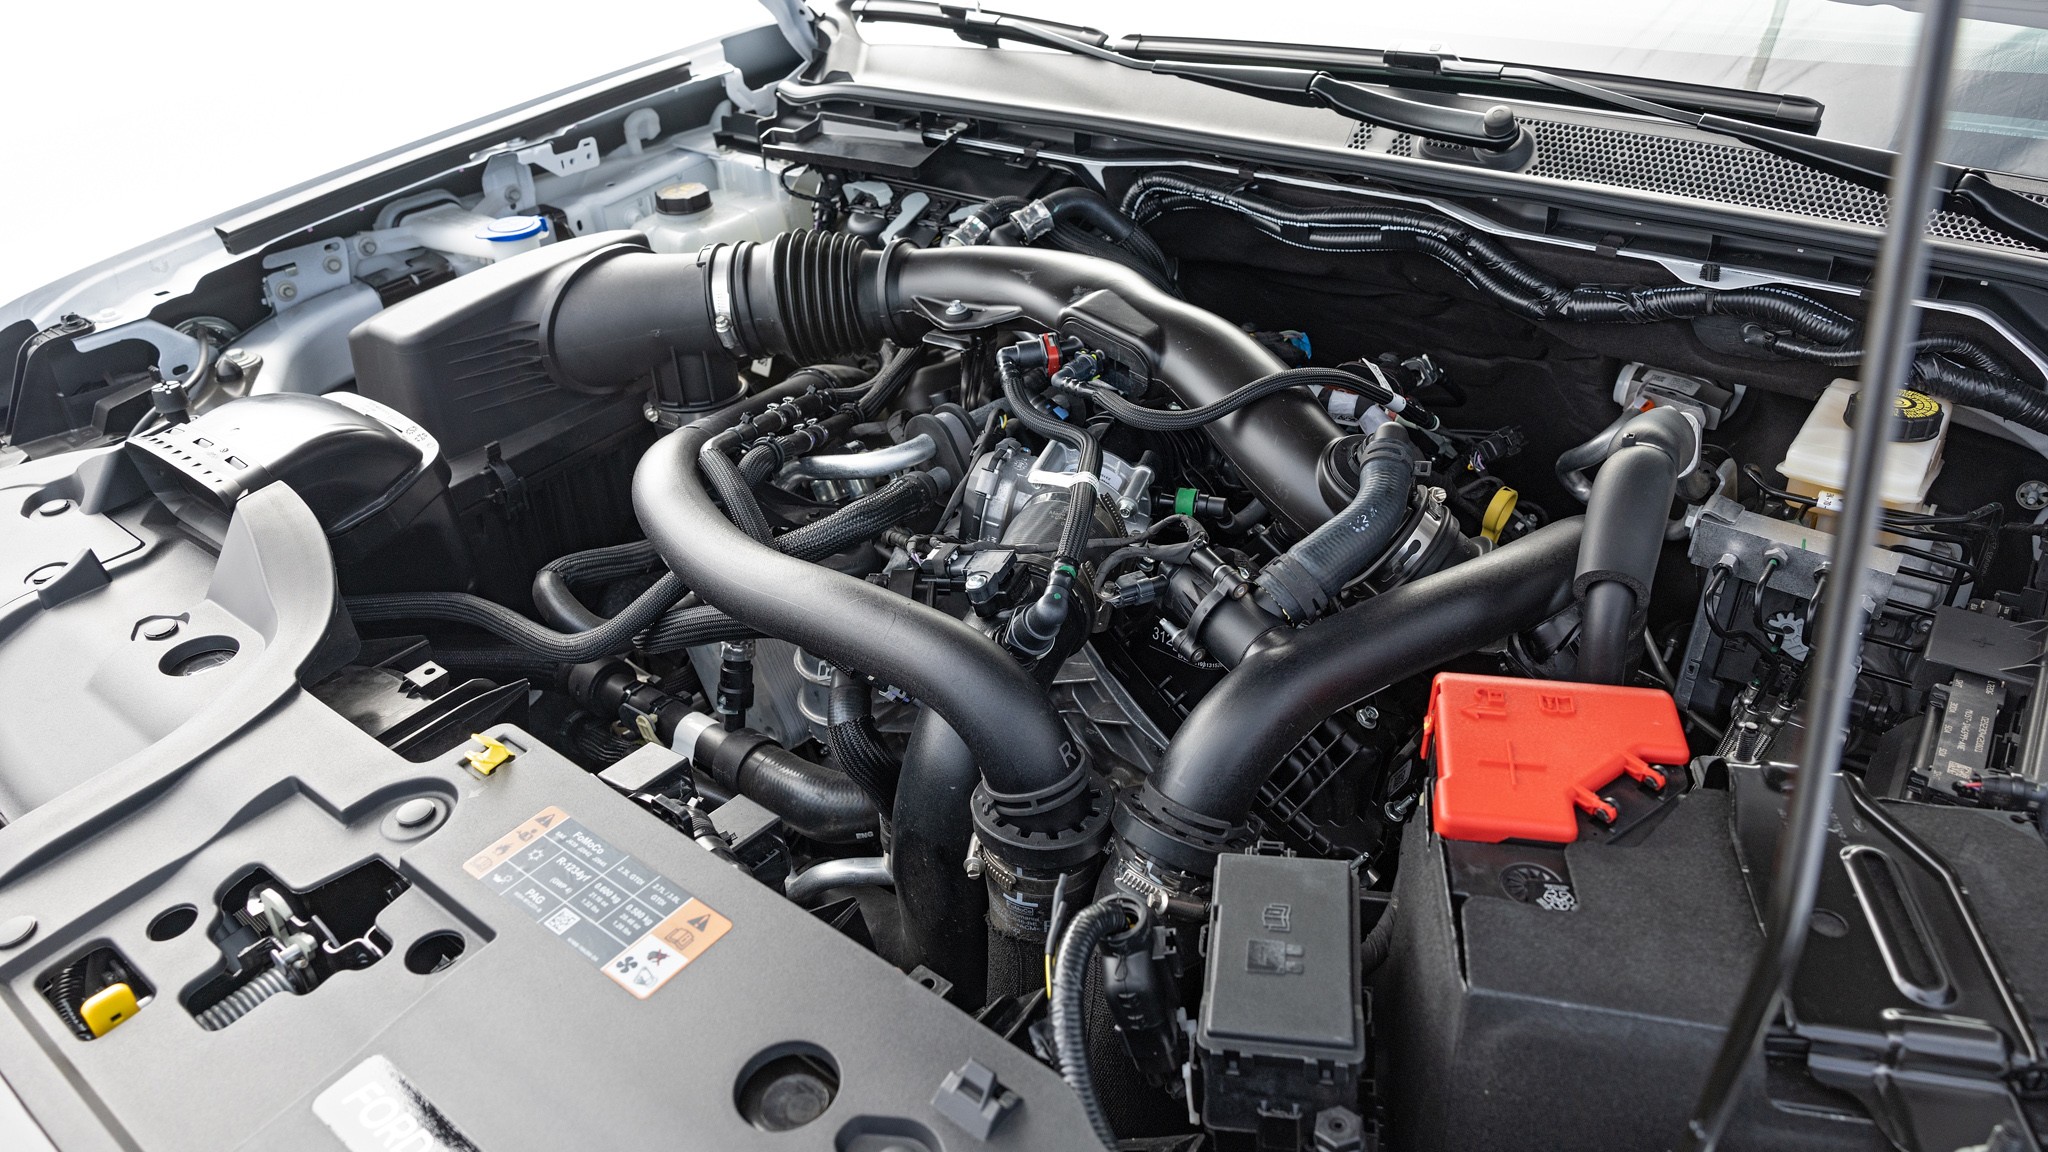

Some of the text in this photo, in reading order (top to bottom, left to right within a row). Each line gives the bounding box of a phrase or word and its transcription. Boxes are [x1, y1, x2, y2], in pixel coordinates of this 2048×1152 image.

[1058, 741, 1077, 768] R
[572, 831, 605, 854] FoMoCo
[855, 831, 874, 839] ENG
[555, 856, 591, 882] R-1234yf
[525, 888, 545, 904] PAG
[608, 894, 621, 904] kg
[639, 916, 653, 926] kg
